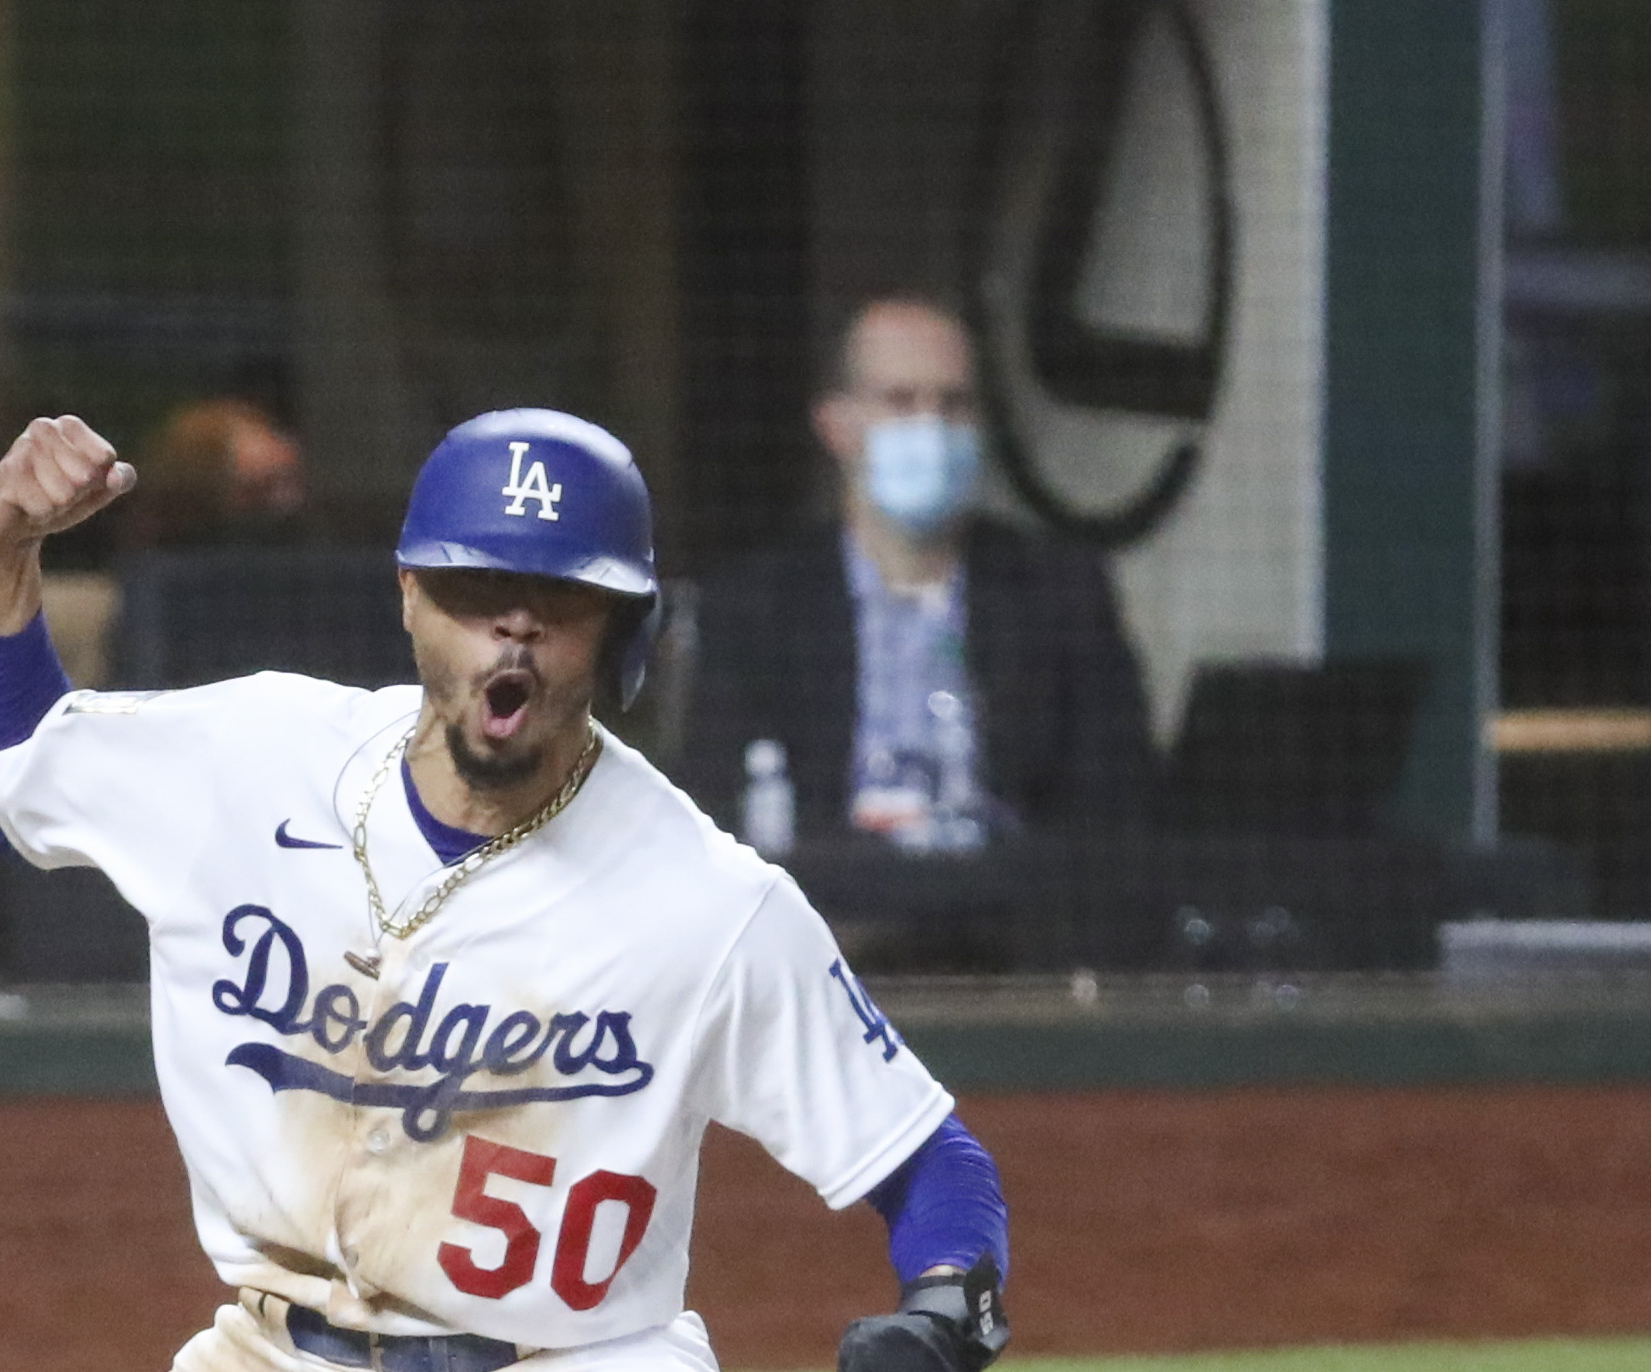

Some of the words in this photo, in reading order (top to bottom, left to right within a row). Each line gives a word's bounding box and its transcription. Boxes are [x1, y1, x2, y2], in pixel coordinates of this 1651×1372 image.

[502, 441, 562, 520] LA
[212, 903, 654, 1142] Dodgers
[437, 1135, 657, 1311] 50
